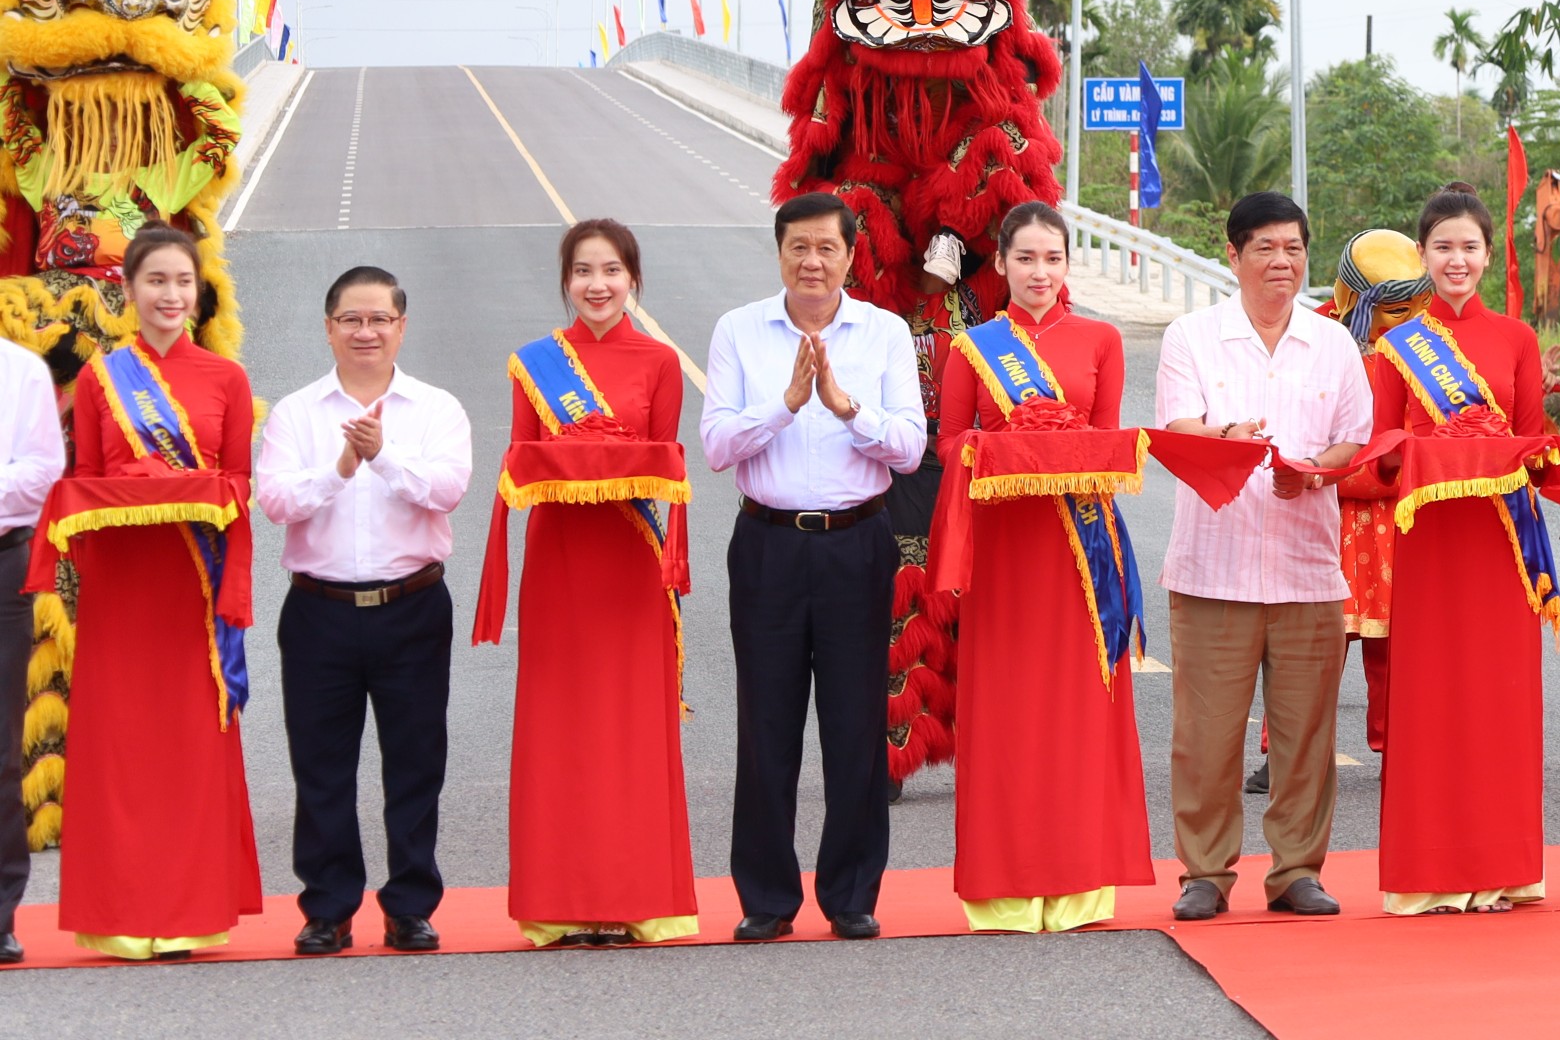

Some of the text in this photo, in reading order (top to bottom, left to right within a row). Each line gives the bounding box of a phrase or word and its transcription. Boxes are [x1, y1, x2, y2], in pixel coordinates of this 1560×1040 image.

[998, 352, 1031, 386] KÍNH
[1405, 332, 1466, 405] KÍNH CHÀO
[558, 390, 589, 422] KÍN
